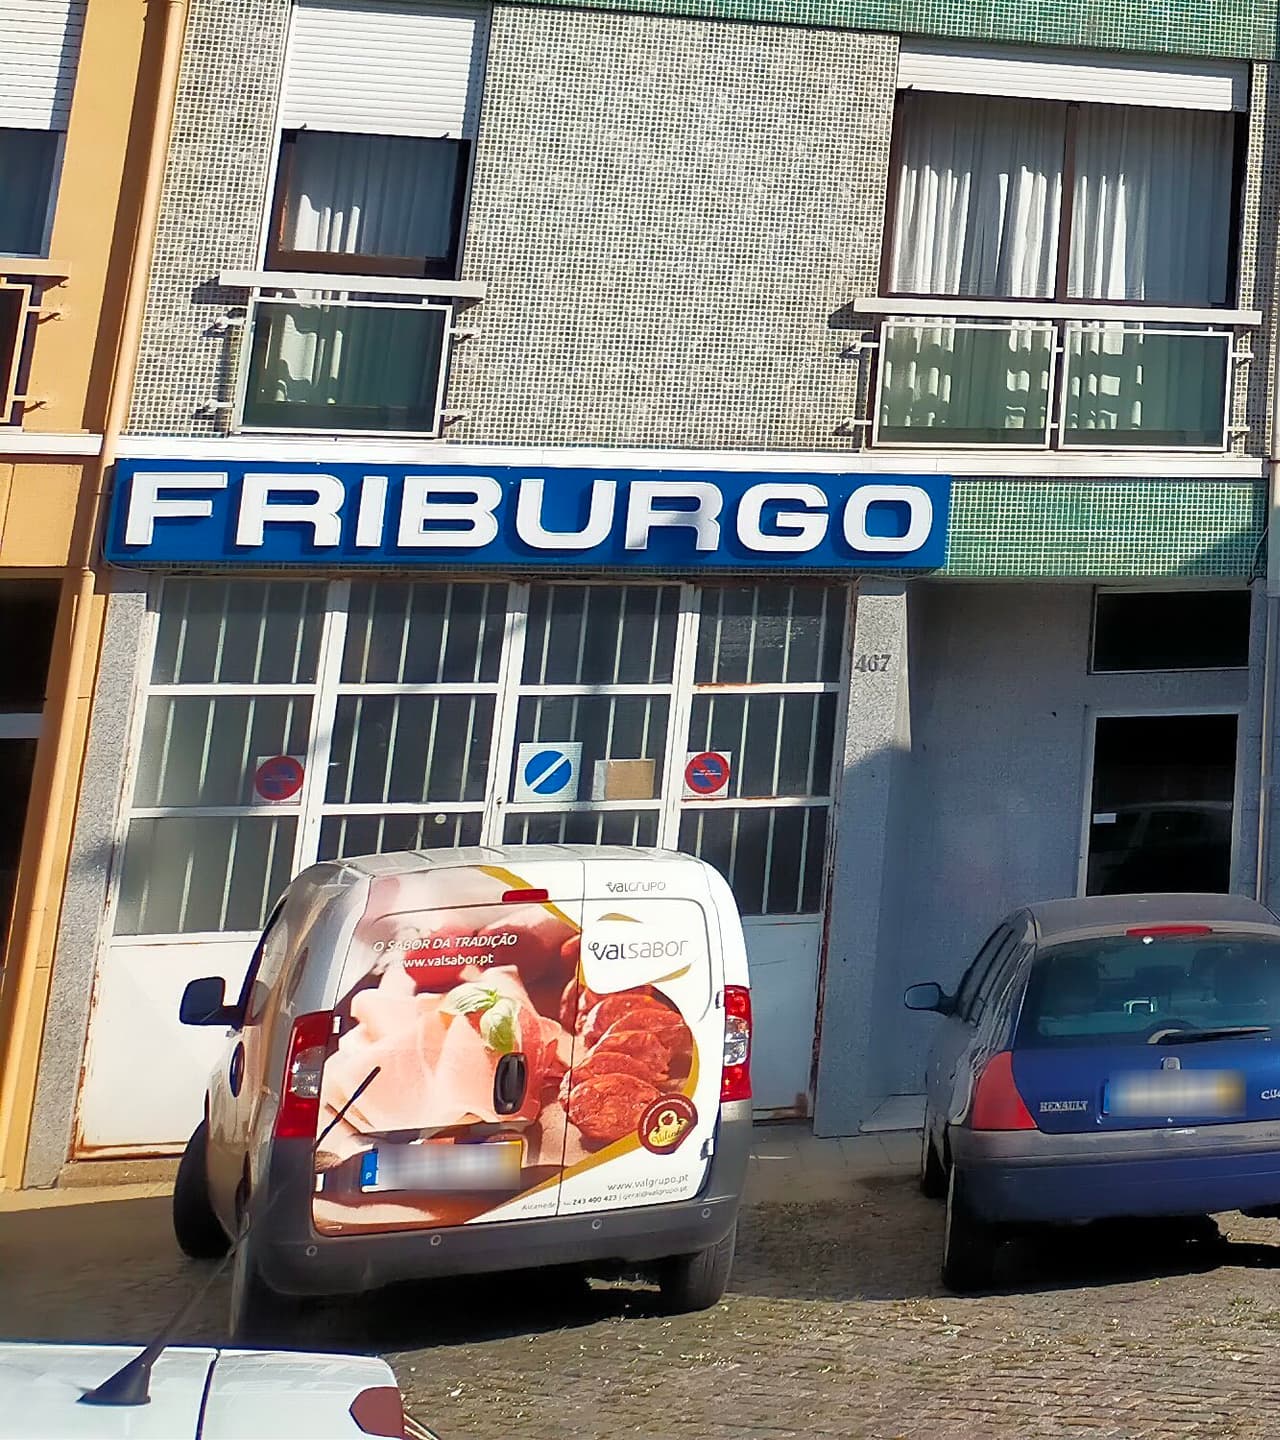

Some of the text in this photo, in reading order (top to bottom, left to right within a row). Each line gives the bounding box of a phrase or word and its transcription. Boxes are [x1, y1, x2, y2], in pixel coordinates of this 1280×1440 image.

[124, 471, 932, 553] FRIBURGO
[855, 654, 892, 672] 467
[373, 933, 518, 952] O SABOR DA TRADIÇÃO
[1039, 1101, 1088, 1112] RENAULT
[607, 1174, 689, 1191] www.valgrupo.pt
